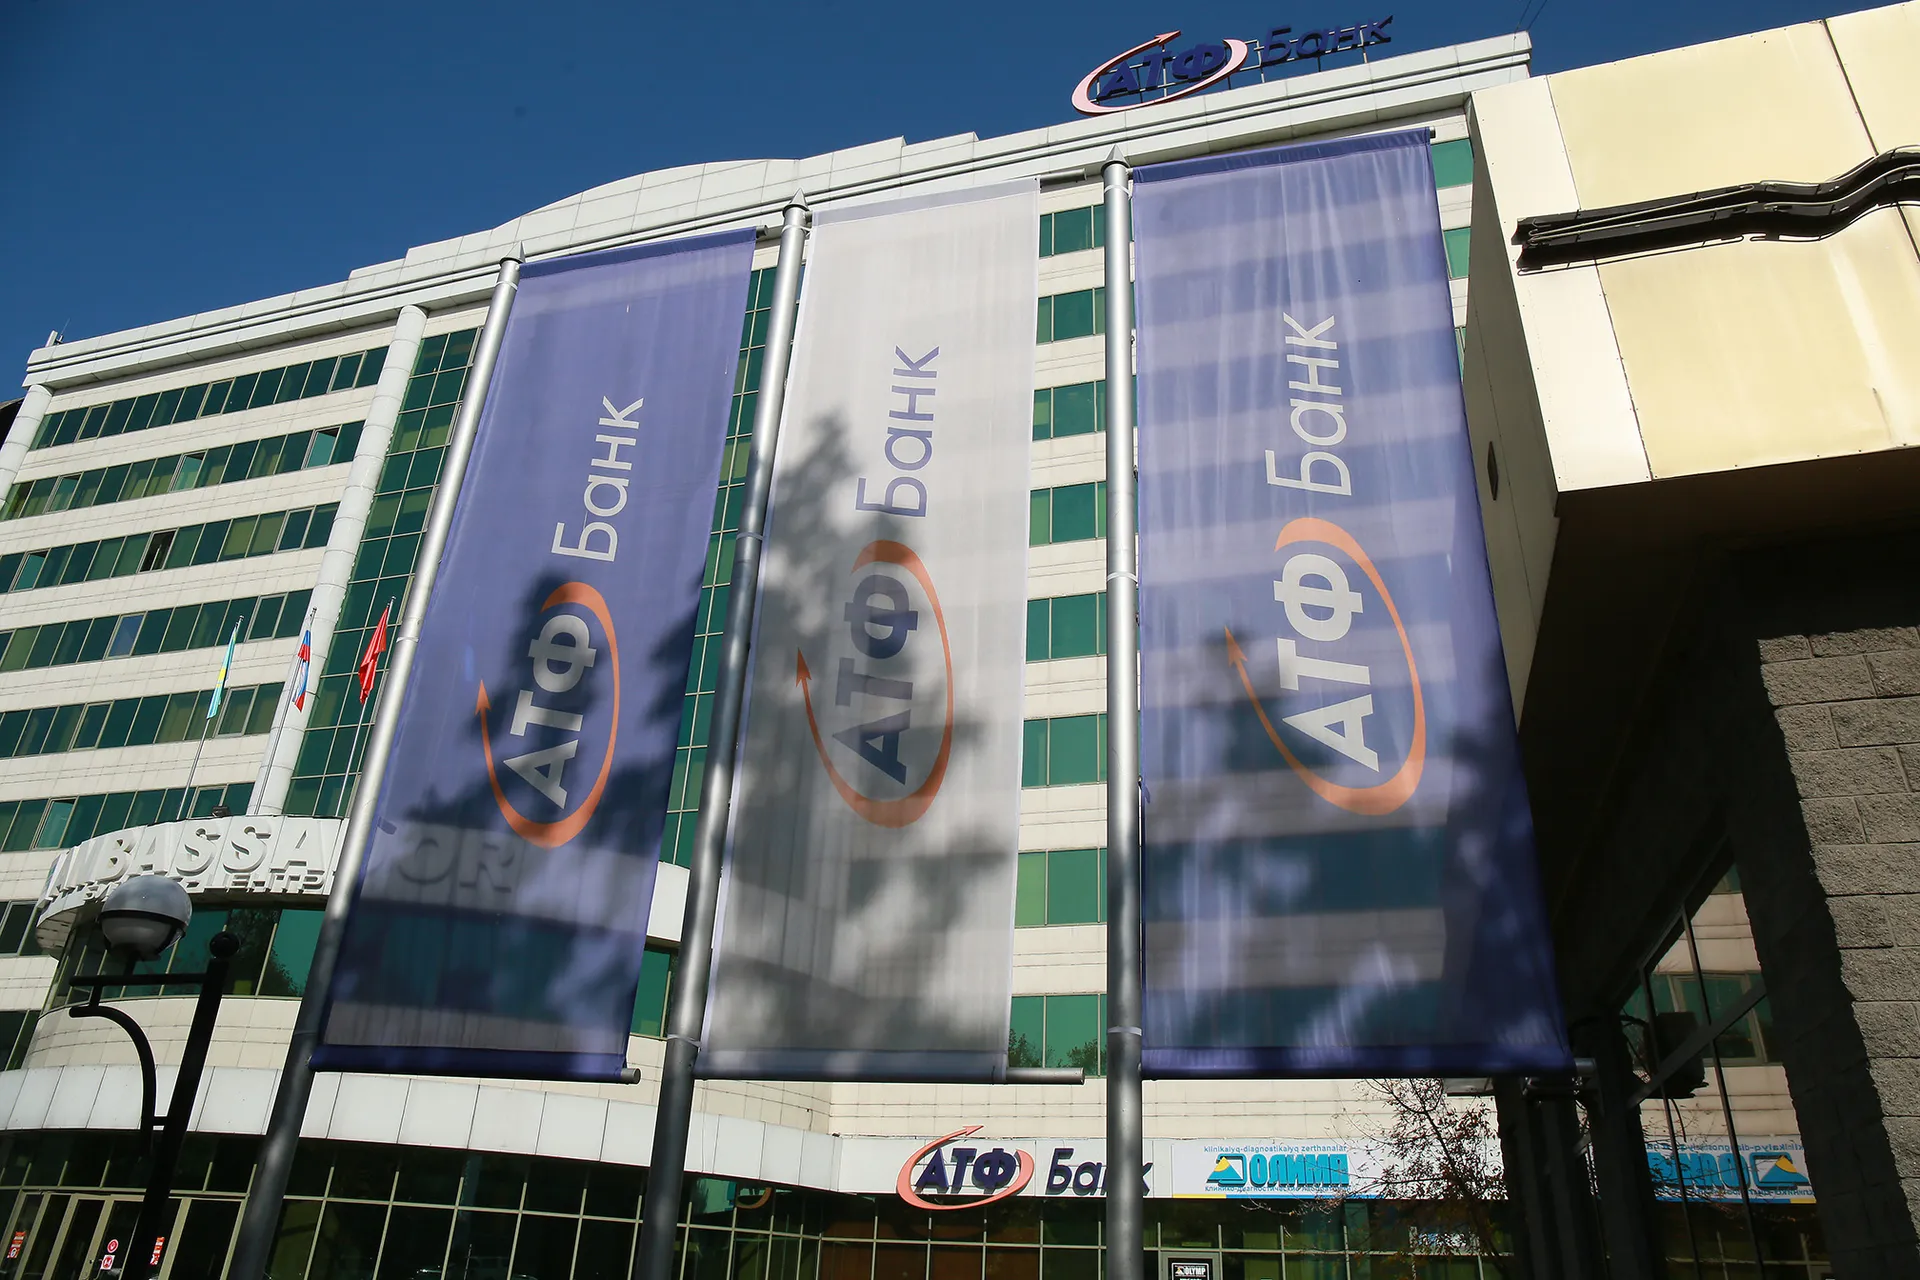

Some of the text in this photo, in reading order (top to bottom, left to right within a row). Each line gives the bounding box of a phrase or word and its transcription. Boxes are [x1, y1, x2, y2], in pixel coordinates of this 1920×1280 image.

[1097, 15, 1393, 100] АТФ Банк
[503, 395, 644, 809] АТФ Банк
[832, 345, 939, 786] АТФ Банк
[1265, 311, 1379, 772] АТФ Банк
[913, 1147, 1154, 1197] АТФ Бак
[1249, 1153, 1350, 1187] ОЛИМП
